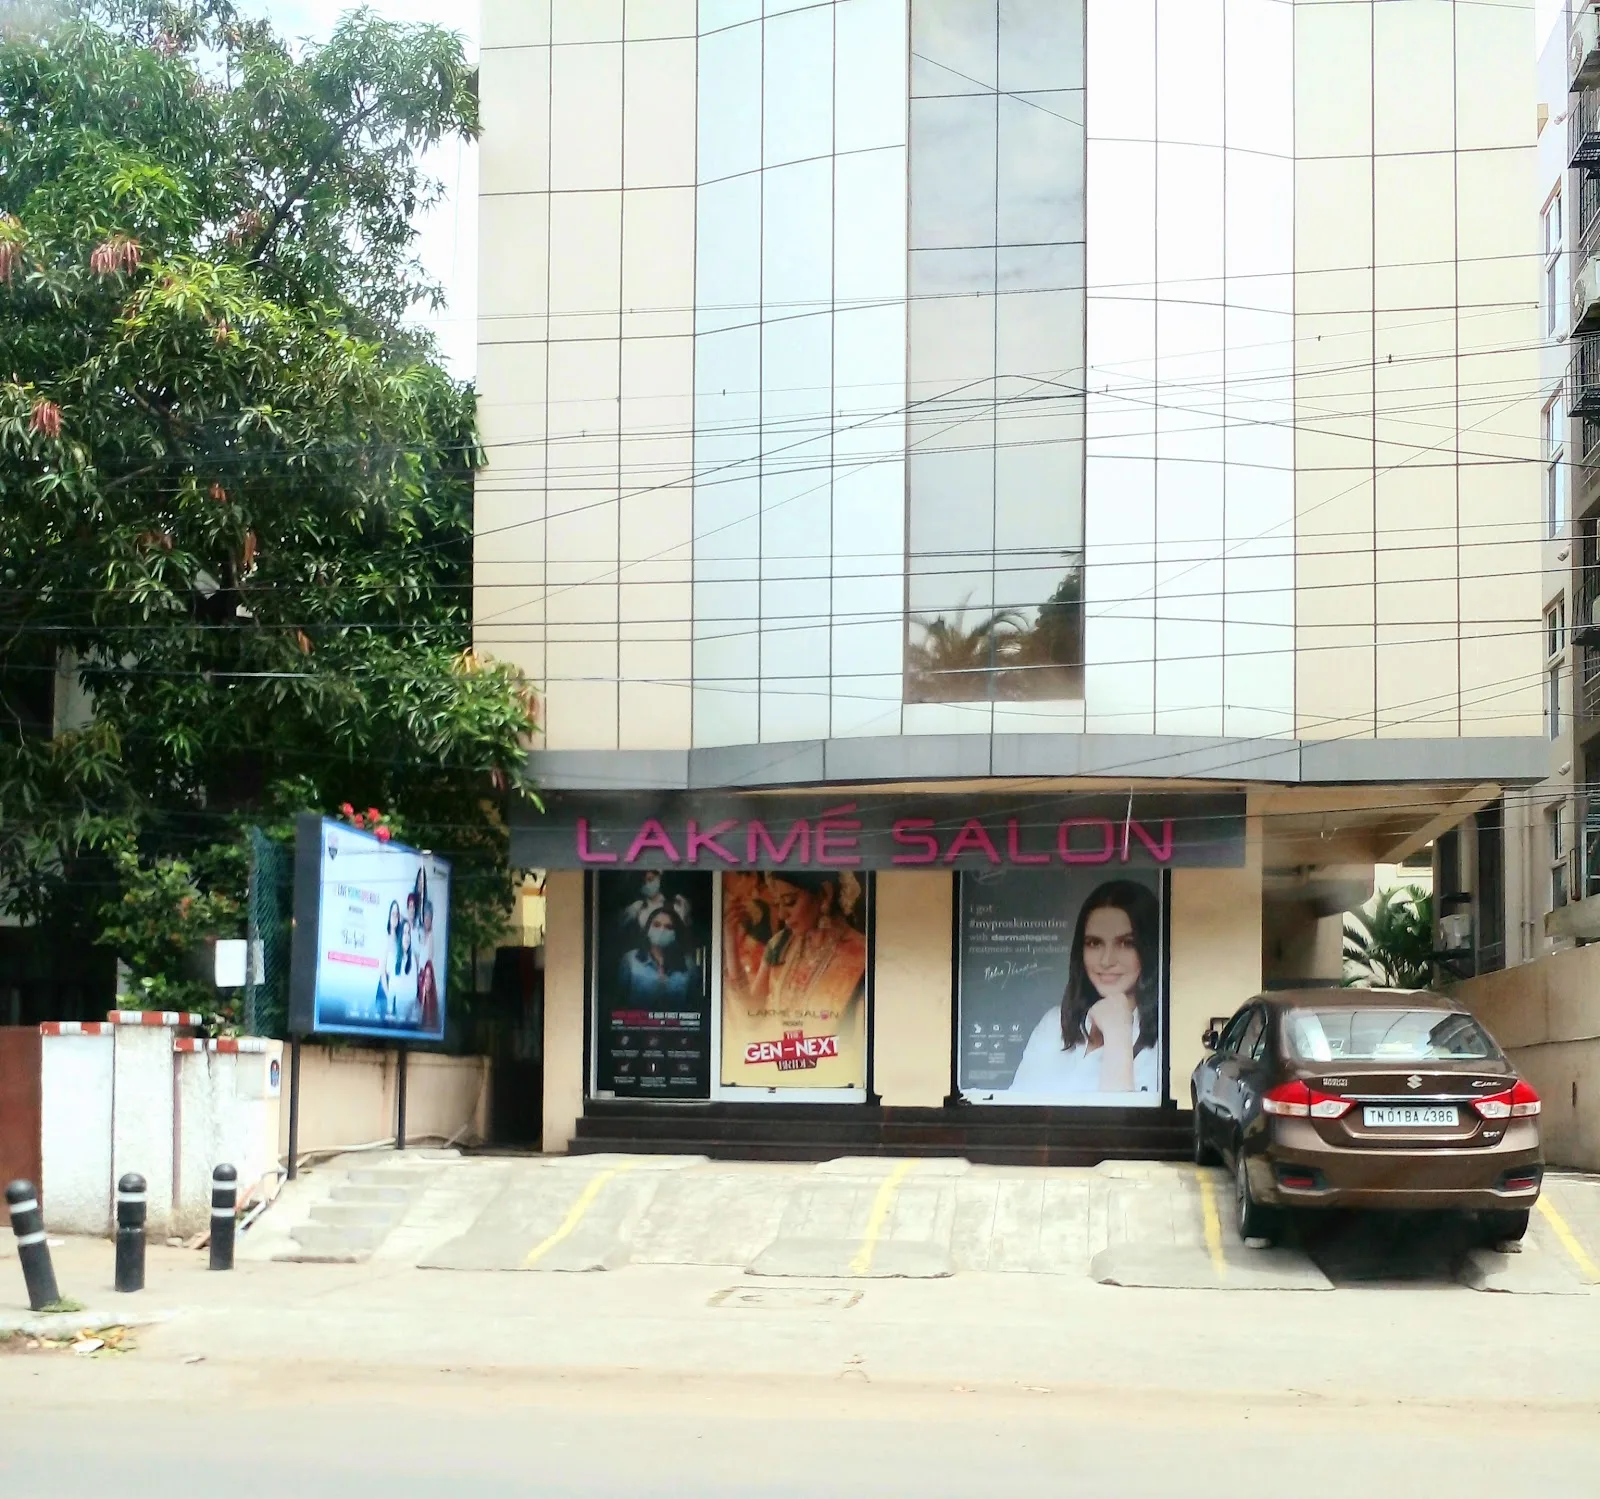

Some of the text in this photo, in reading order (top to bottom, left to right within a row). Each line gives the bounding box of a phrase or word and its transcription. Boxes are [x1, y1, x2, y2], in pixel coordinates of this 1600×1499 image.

[576, 803, 1174, 864] LAKMÉ SALON
[976, 904, 993, 916] got
[969, 932, 988, 941] with
[1014, 944, 1030, 953] and
[795, 1009, 839, 1019] SALON
[1370, 1110, 1453, 1123] TN 01 BA 4386
